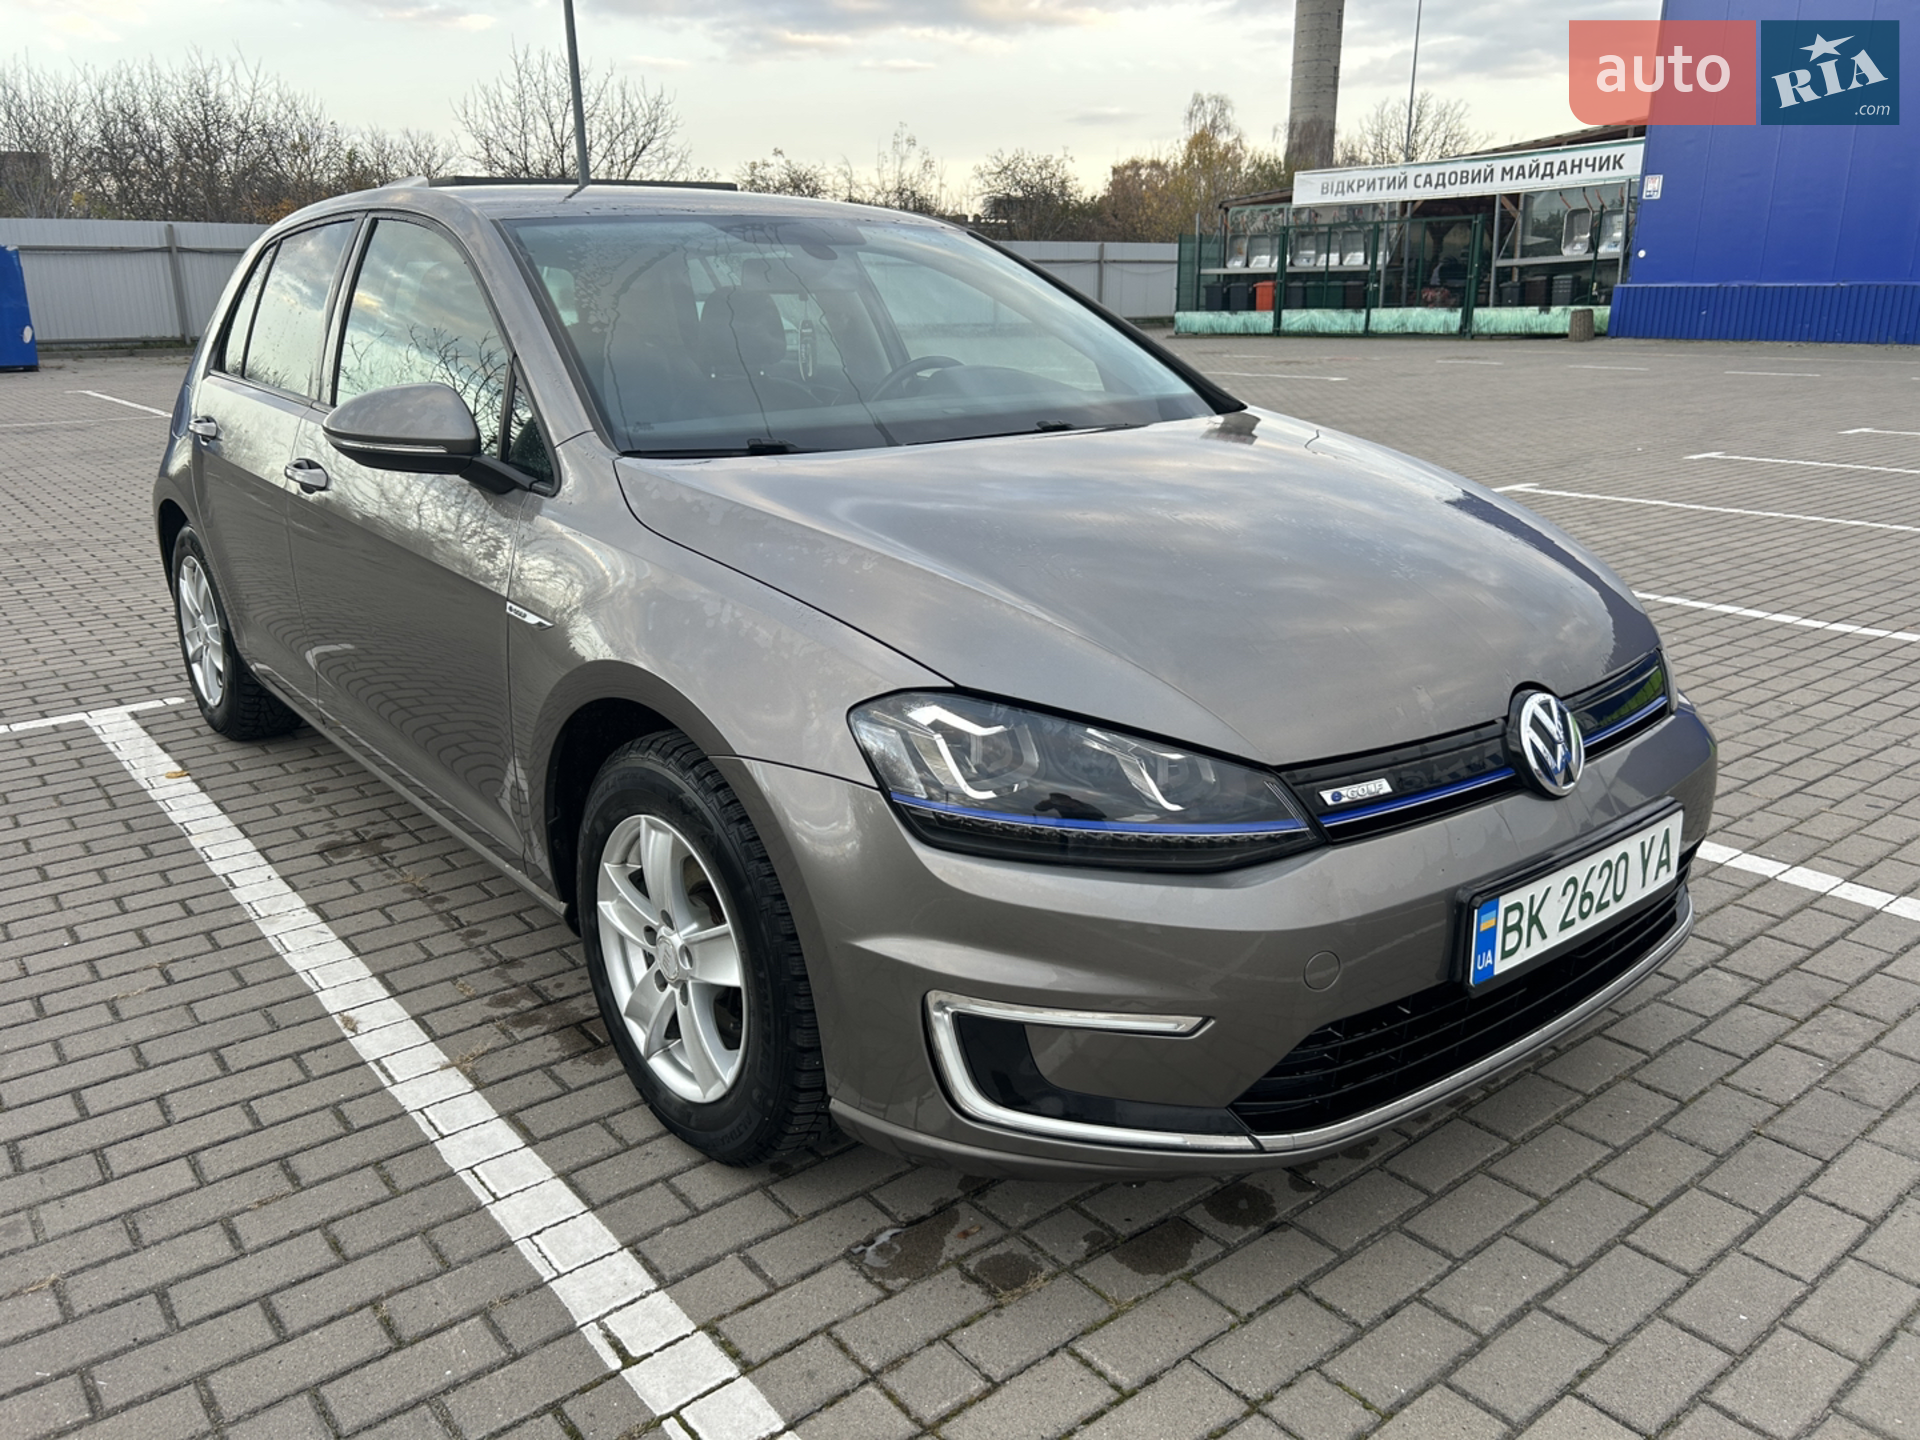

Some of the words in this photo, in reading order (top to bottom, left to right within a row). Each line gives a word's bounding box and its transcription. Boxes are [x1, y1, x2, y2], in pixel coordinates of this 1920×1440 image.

[1320, 171, 1408, 196] ВІДКРИТИЙ
[1413, 163, 1495, 190] САДОВИЙ
[1500, 152, 1626, 182] МАЙДАНЧИК
[1500, 884, 1552, 961] BK
[1558, 851, 1630, 933] 2620
[1640, 827, 1672, 889] YA
[1476, 949, 1494, 971] UA
